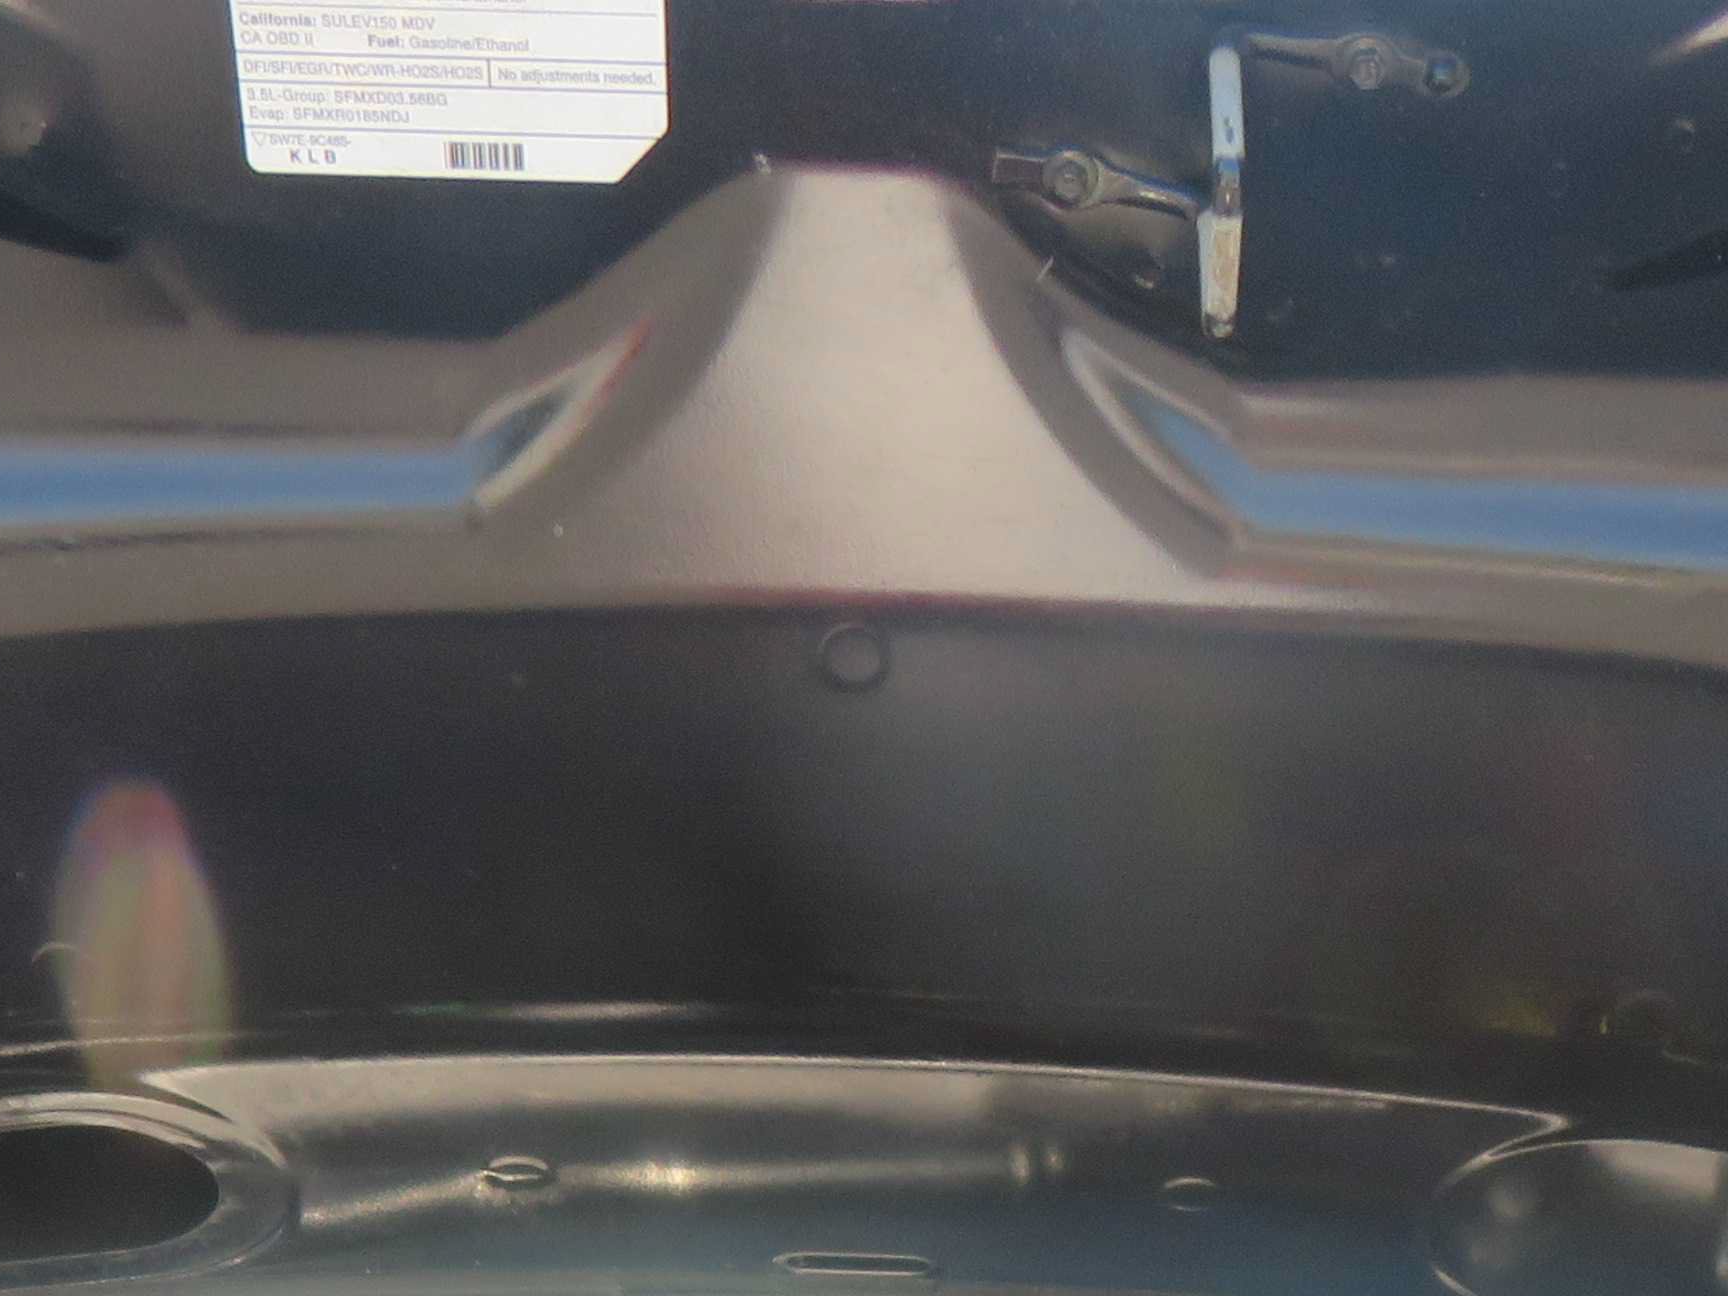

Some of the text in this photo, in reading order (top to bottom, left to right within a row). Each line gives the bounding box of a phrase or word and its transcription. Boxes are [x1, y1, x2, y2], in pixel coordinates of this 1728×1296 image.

[239, 11, 435, 31] California: SULEV150 MDV
[240, 31, 263, 46] CA
[267, 32, 301, 46] OBD
[367, 34, 530, 52] Fuel: Gasoline/Ethanol
[498, 68, 657, 86] No adjustments needed.
[248, 105, 289, 121] Evap:
[289, 149, 303, 164] K
[308, 149, 320, 165] L
